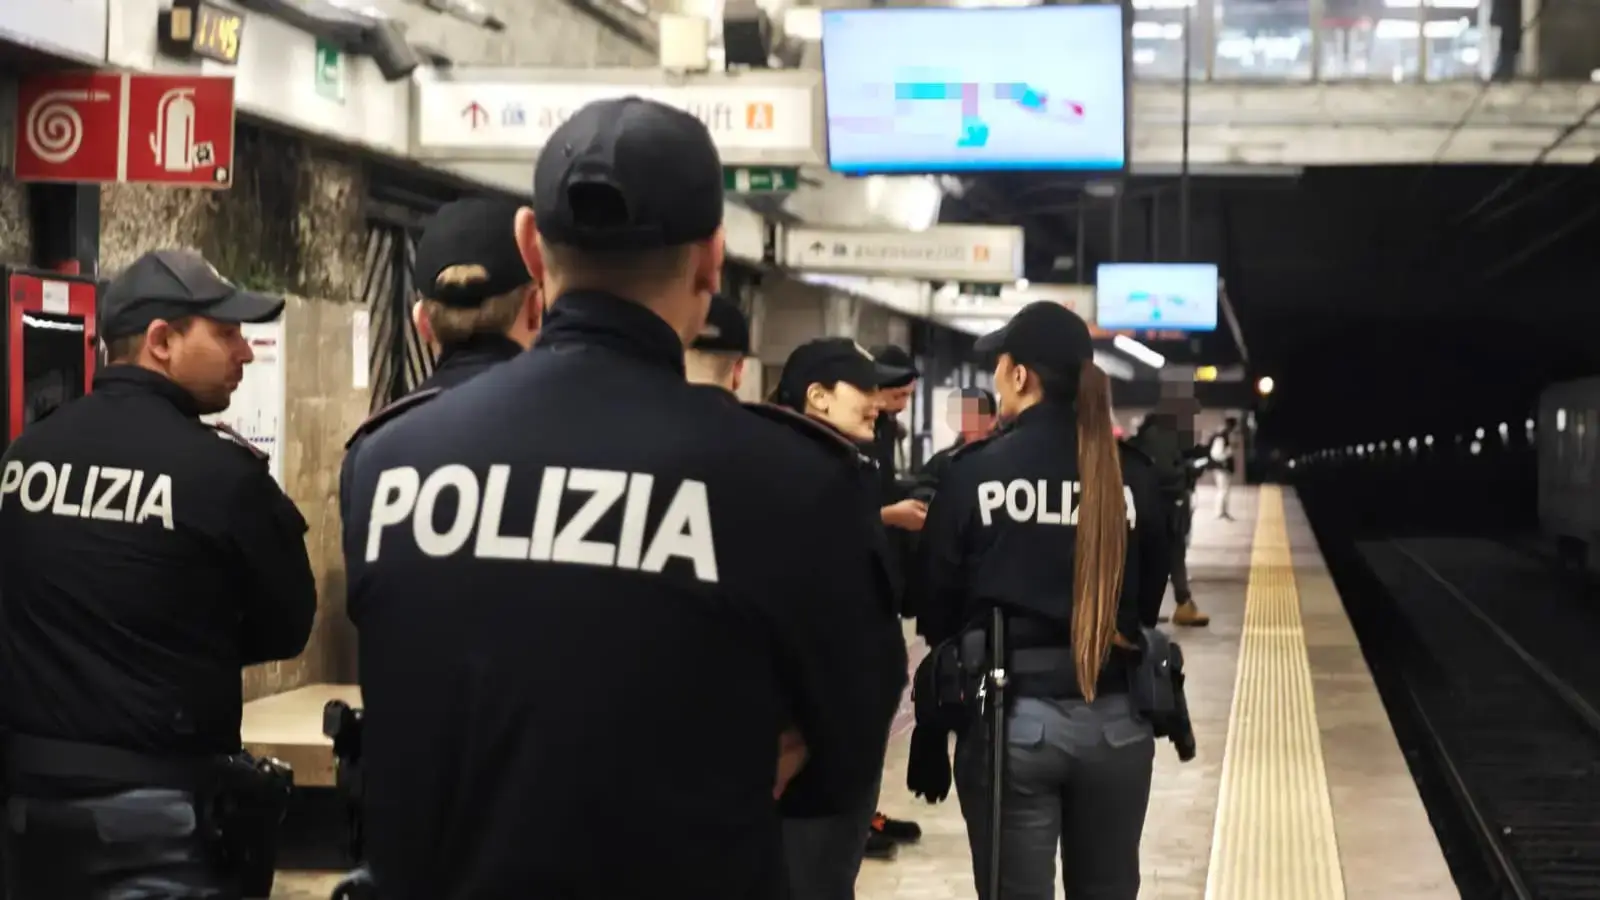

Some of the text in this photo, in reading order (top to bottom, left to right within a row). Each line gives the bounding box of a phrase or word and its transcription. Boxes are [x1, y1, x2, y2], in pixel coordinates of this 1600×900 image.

[0, 460, 174, 530] POLIZIA
[365, 463, 719, 583] POLIZIA
[978, 479, 1137, 529] POLIA
